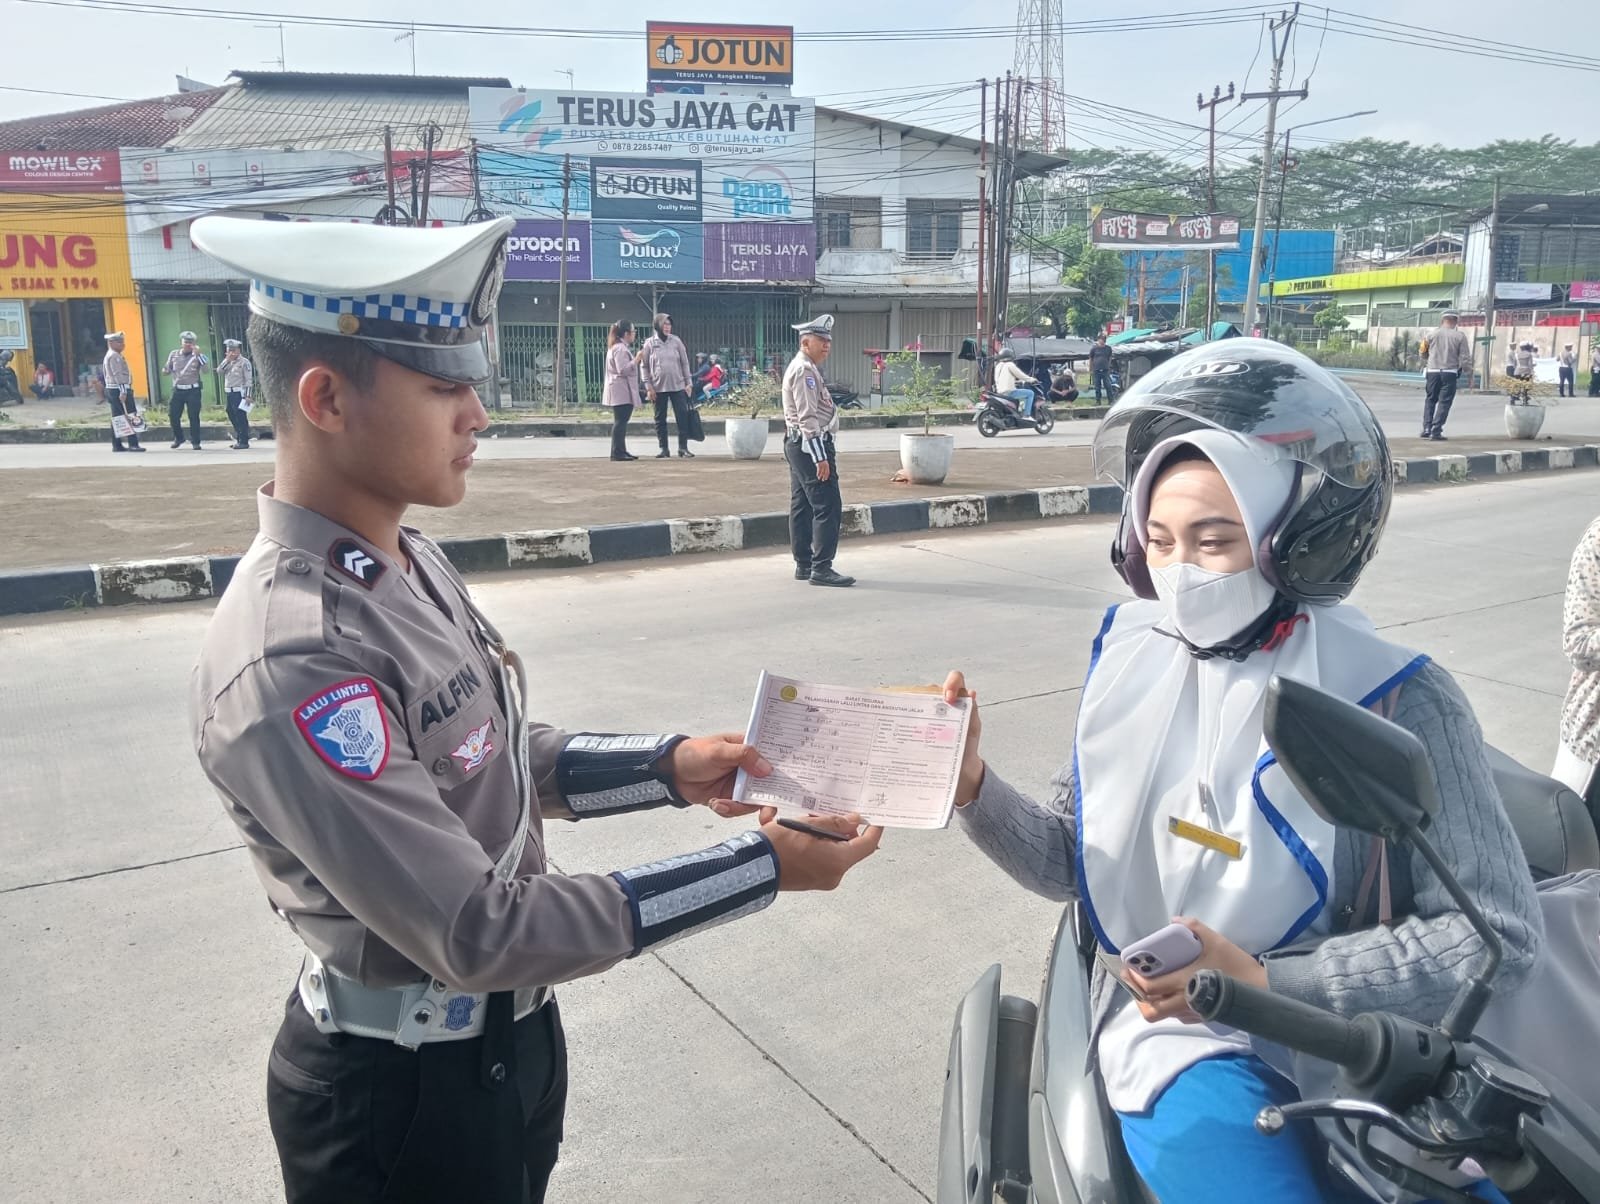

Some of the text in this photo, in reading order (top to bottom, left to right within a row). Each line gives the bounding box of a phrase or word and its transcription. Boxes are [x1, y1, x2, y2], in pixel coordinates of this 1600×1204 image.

[687, 38, 785, 66] JOTUN
[557, 96, 800, 132] TERUS JAYA CAT
[570, 129, 788, 144] PUSAT SEGALA KEBUTUHAN CAT
[704, 145, 764, 154] @terusjaya_cat
[622, 175, 692, 195] JOTUN
[506, 236, 580, 253] propan
[620, 242, 673, 258] Dulux
[730, 244, 808, 256] TERUS JAYA
[507, 254, 580, 263] The Paint Specalist
[620, 259, 673, 269] let's colour
[731, 260, 757, 272] CAT
[11, 277, 99, 290] SEJAK 1994
[1293, 280, 1327, 292] PERTAMINA
[299, 683, 369, 720] LALU LINTAS
[421, 663, 481, 733] ALFIN
